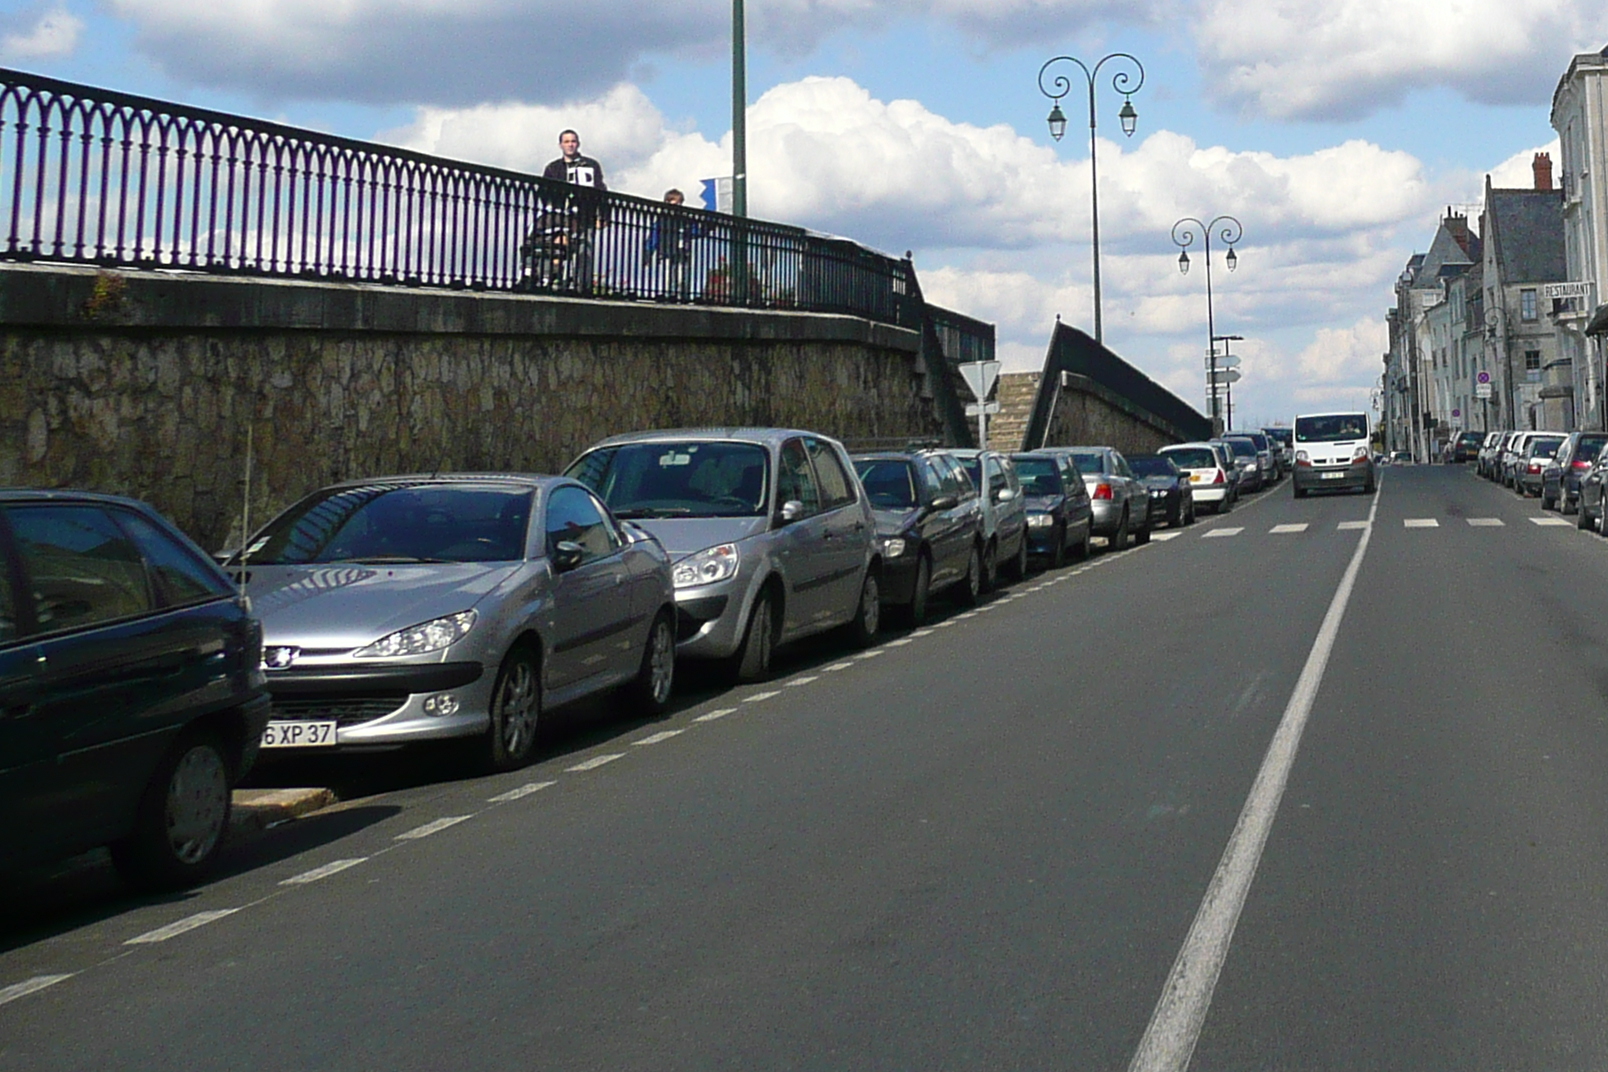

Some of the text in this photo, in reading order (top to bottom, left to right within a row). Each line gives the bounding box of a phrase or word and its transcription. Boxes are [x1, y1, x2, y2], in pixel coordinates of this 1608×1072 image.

[1545, 283, 1589, 298] RESTAURANT
[280, 725, 303, 745] XP
[307, 724, 331, 744] 37
